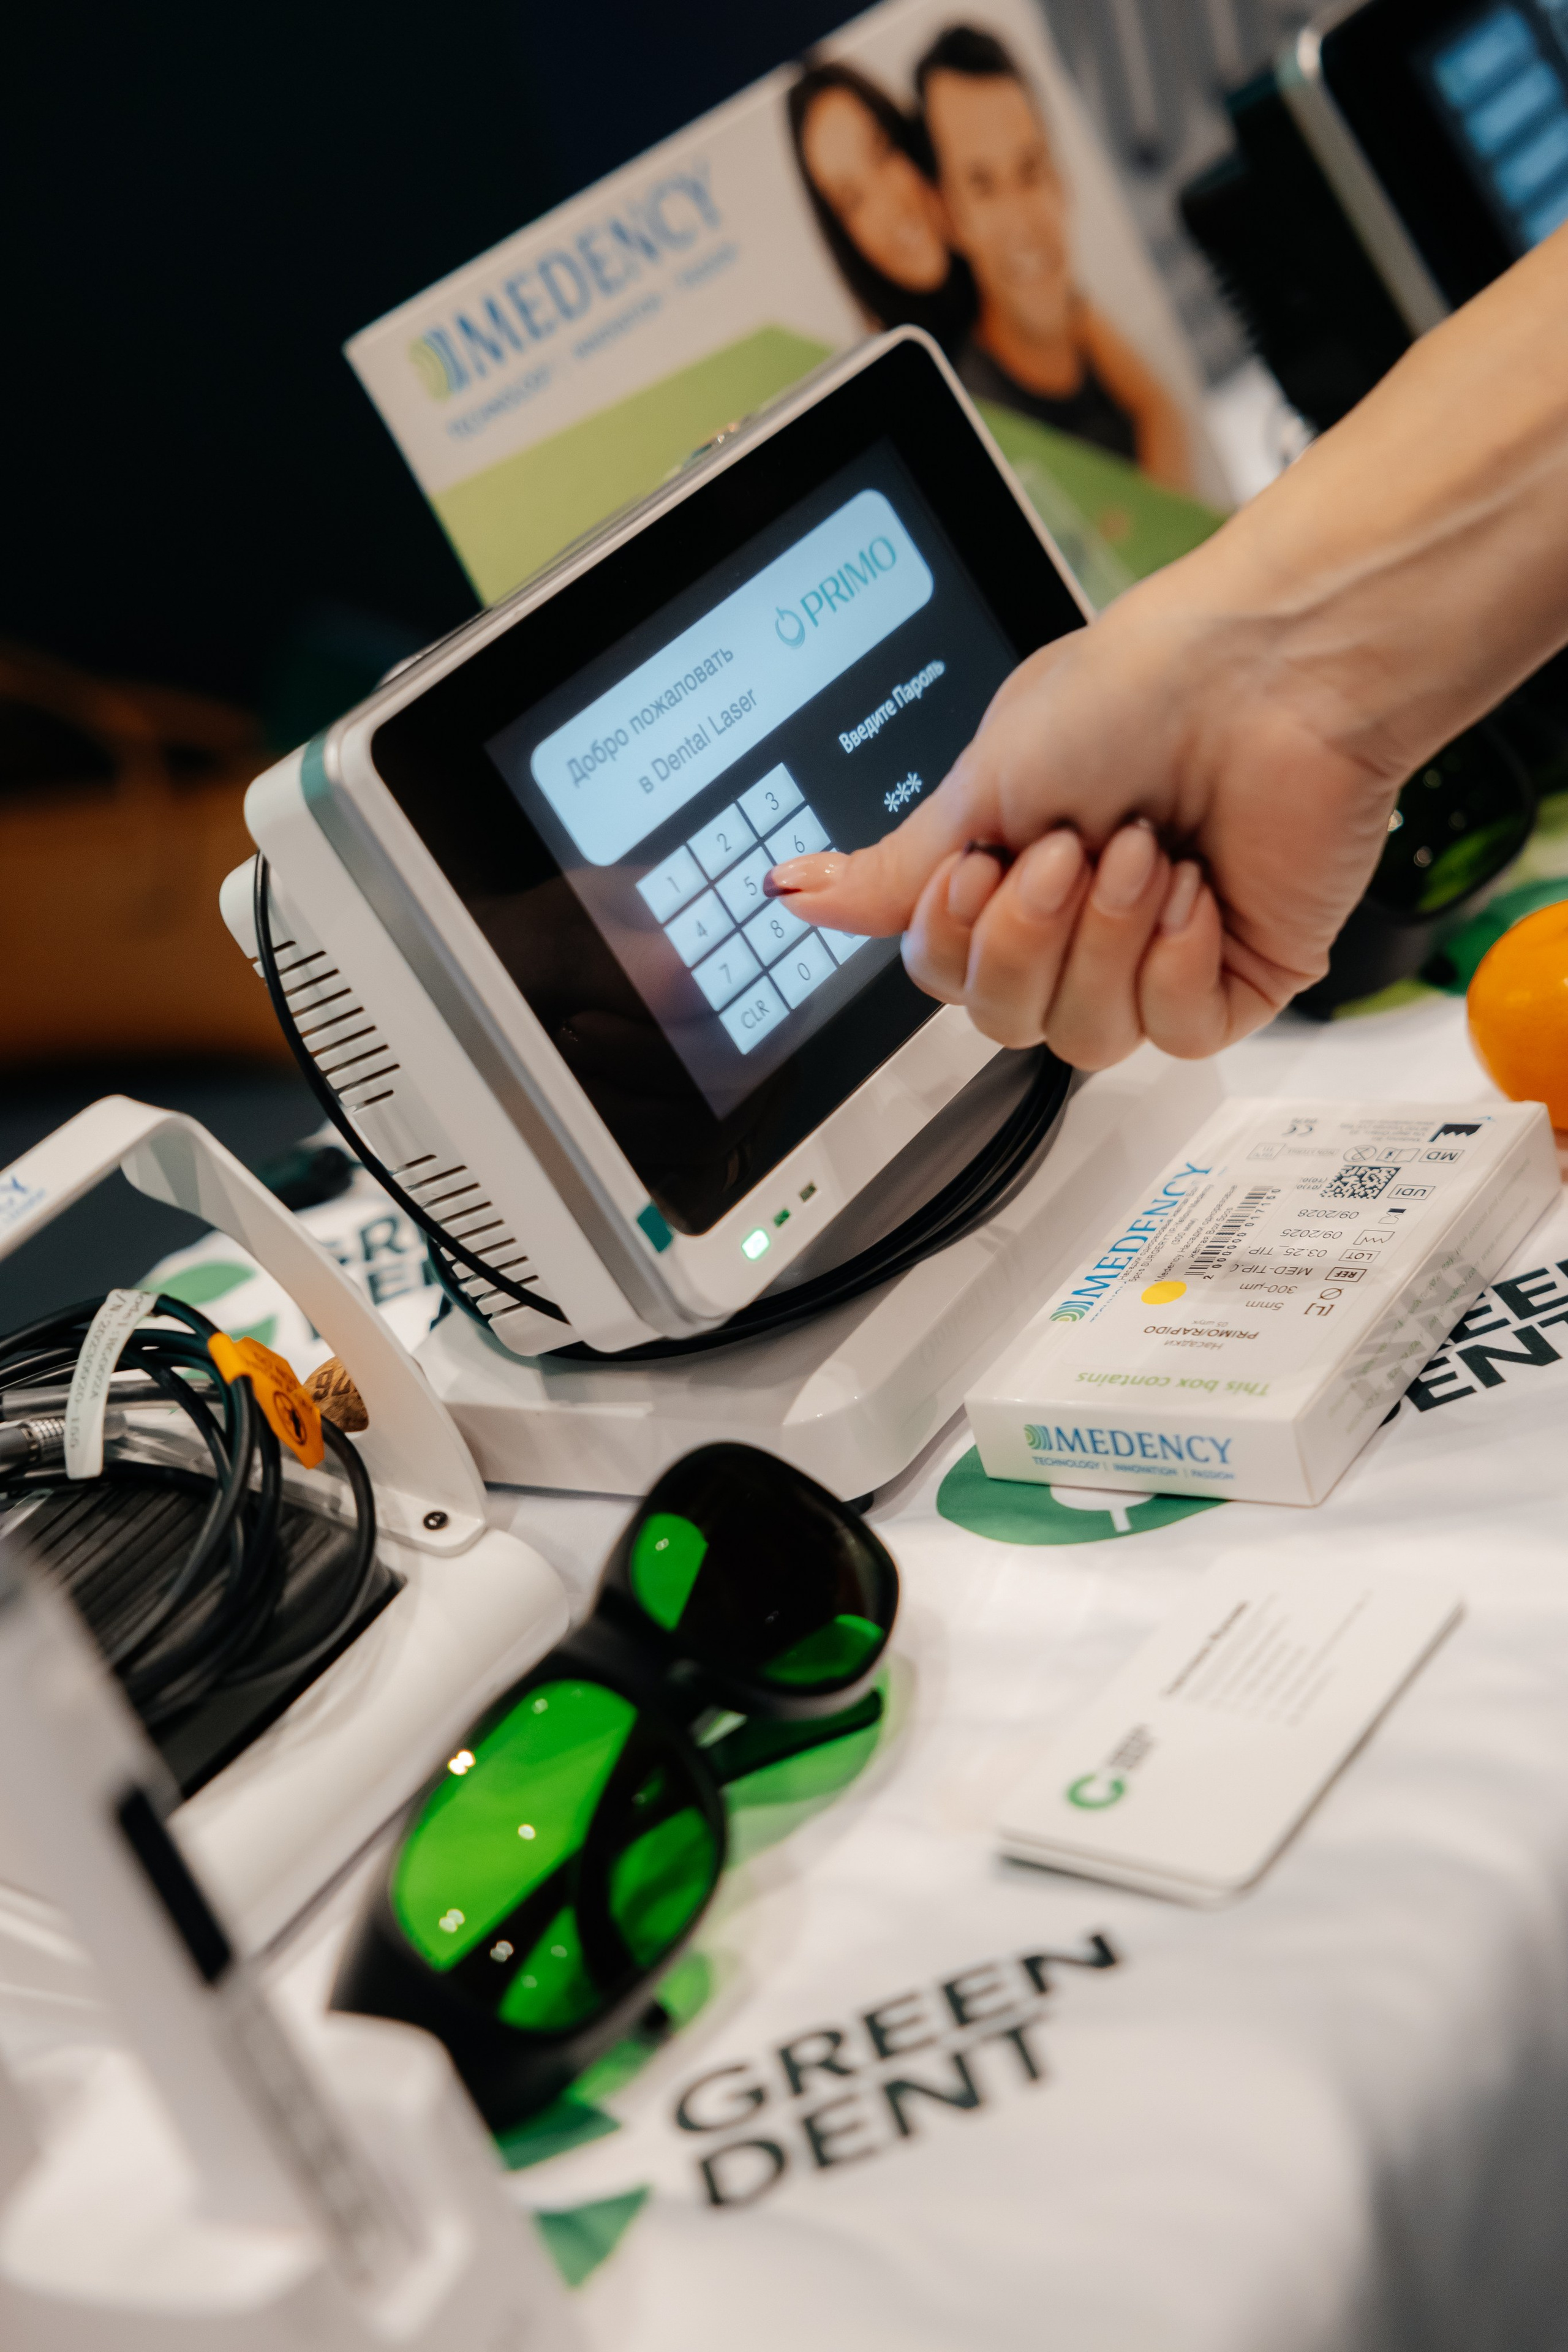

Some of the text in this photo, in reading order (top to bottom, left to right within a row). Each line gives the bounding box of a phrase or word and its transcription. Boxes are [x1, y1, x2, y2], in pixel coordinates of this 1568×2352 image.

[453, 156, 722, 377] MEDENCY
[799, 535, 897, 628] PRIMO
[839, 658, 946, 754] Введите Пароль
[566, 646, 734, 789] Добро пожаловать
[639, 688, 759, 794] в Dental Laser
[766, 792, 778, 811] 3
[717, 833, 732, 853] 2
[794, 835, 805, 854] 6
[666, 877, 680, 894] 1
[744, 877, 757, 896] 5
[696, 921, 708, 939] 4
[770, 921, 785, 938] 8
[720, 964, 731, 984] 7
[741, 999, 770, 1030] CLR
[1425, 1151, 1457, 1160] MD
[1395, 1188, 1426, 1196] UDI
[1297, 1208, 1359, 1219] 09/2028
[1280, 1228, 1342, 1238] 09/2025
[1155, 1255, 1183, 1281] Medency
[1178, 1227, 1205, 1251] Насадки
[1244, 1300, 1284, 1310] 5mm
[1144, 1324, 1257, 1340] PRIMO/RAPIDO
[1164, 1338, 1223, 1349] Насадки
[1074, 1371, 1271, 1394] This box contains
[1055, 1427, 1232, 1464] MEDENCY
[1033, 1457, 1100, 1469] TECHNOLOGY
[671, 1933, 1121, 2132] GREEN
[698, 2012, 1053, 2208] DENT
